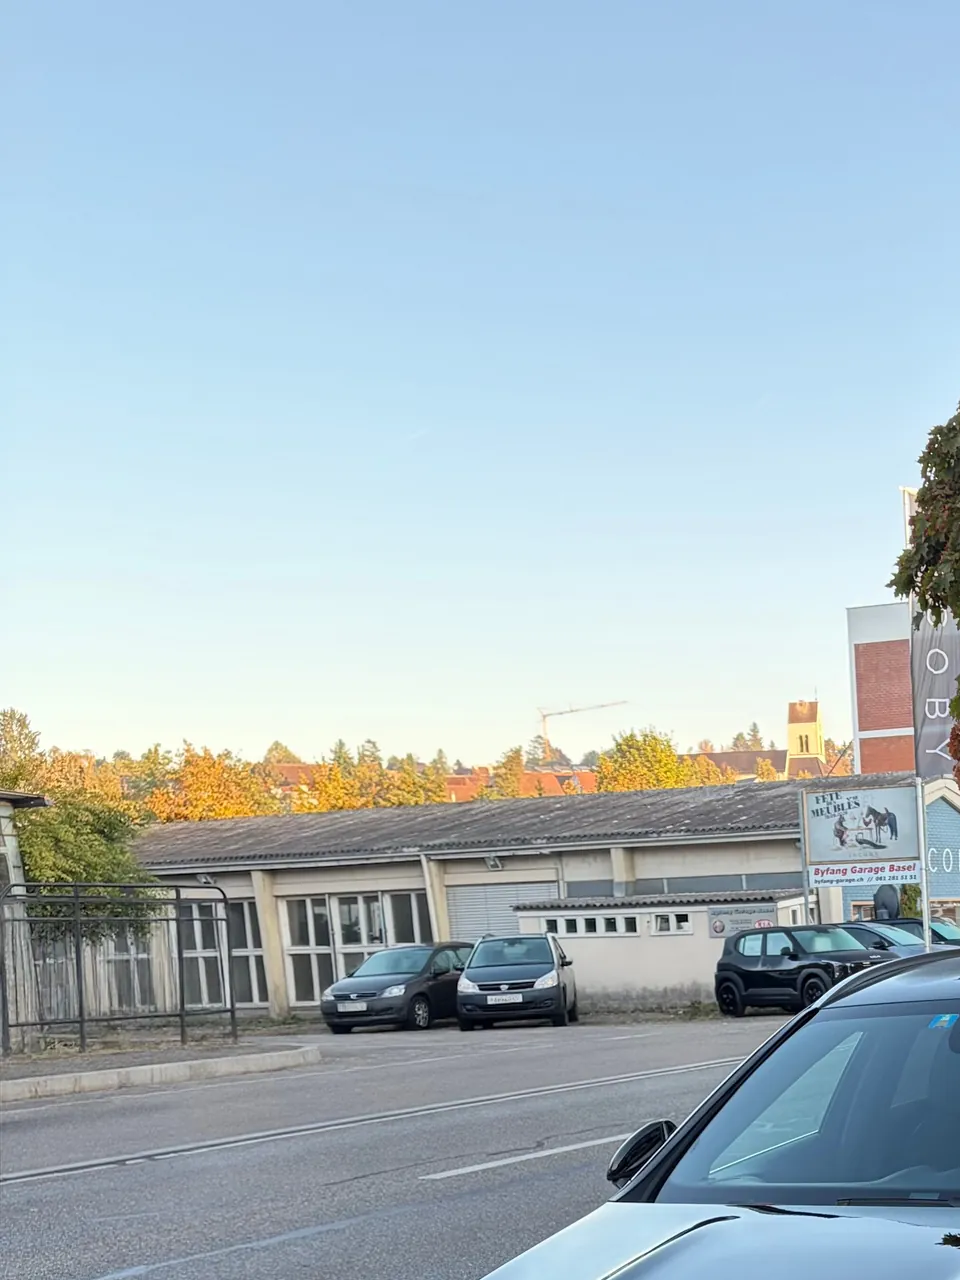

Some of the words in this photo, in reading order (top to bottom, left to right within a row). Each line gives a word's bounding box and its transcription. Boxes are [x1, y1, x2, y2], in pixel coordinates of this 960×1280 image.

[814, 867, 848, 877] Byfang
[850, 865, 886, 875] Garage
[889, 863, 917, 873] Basel
